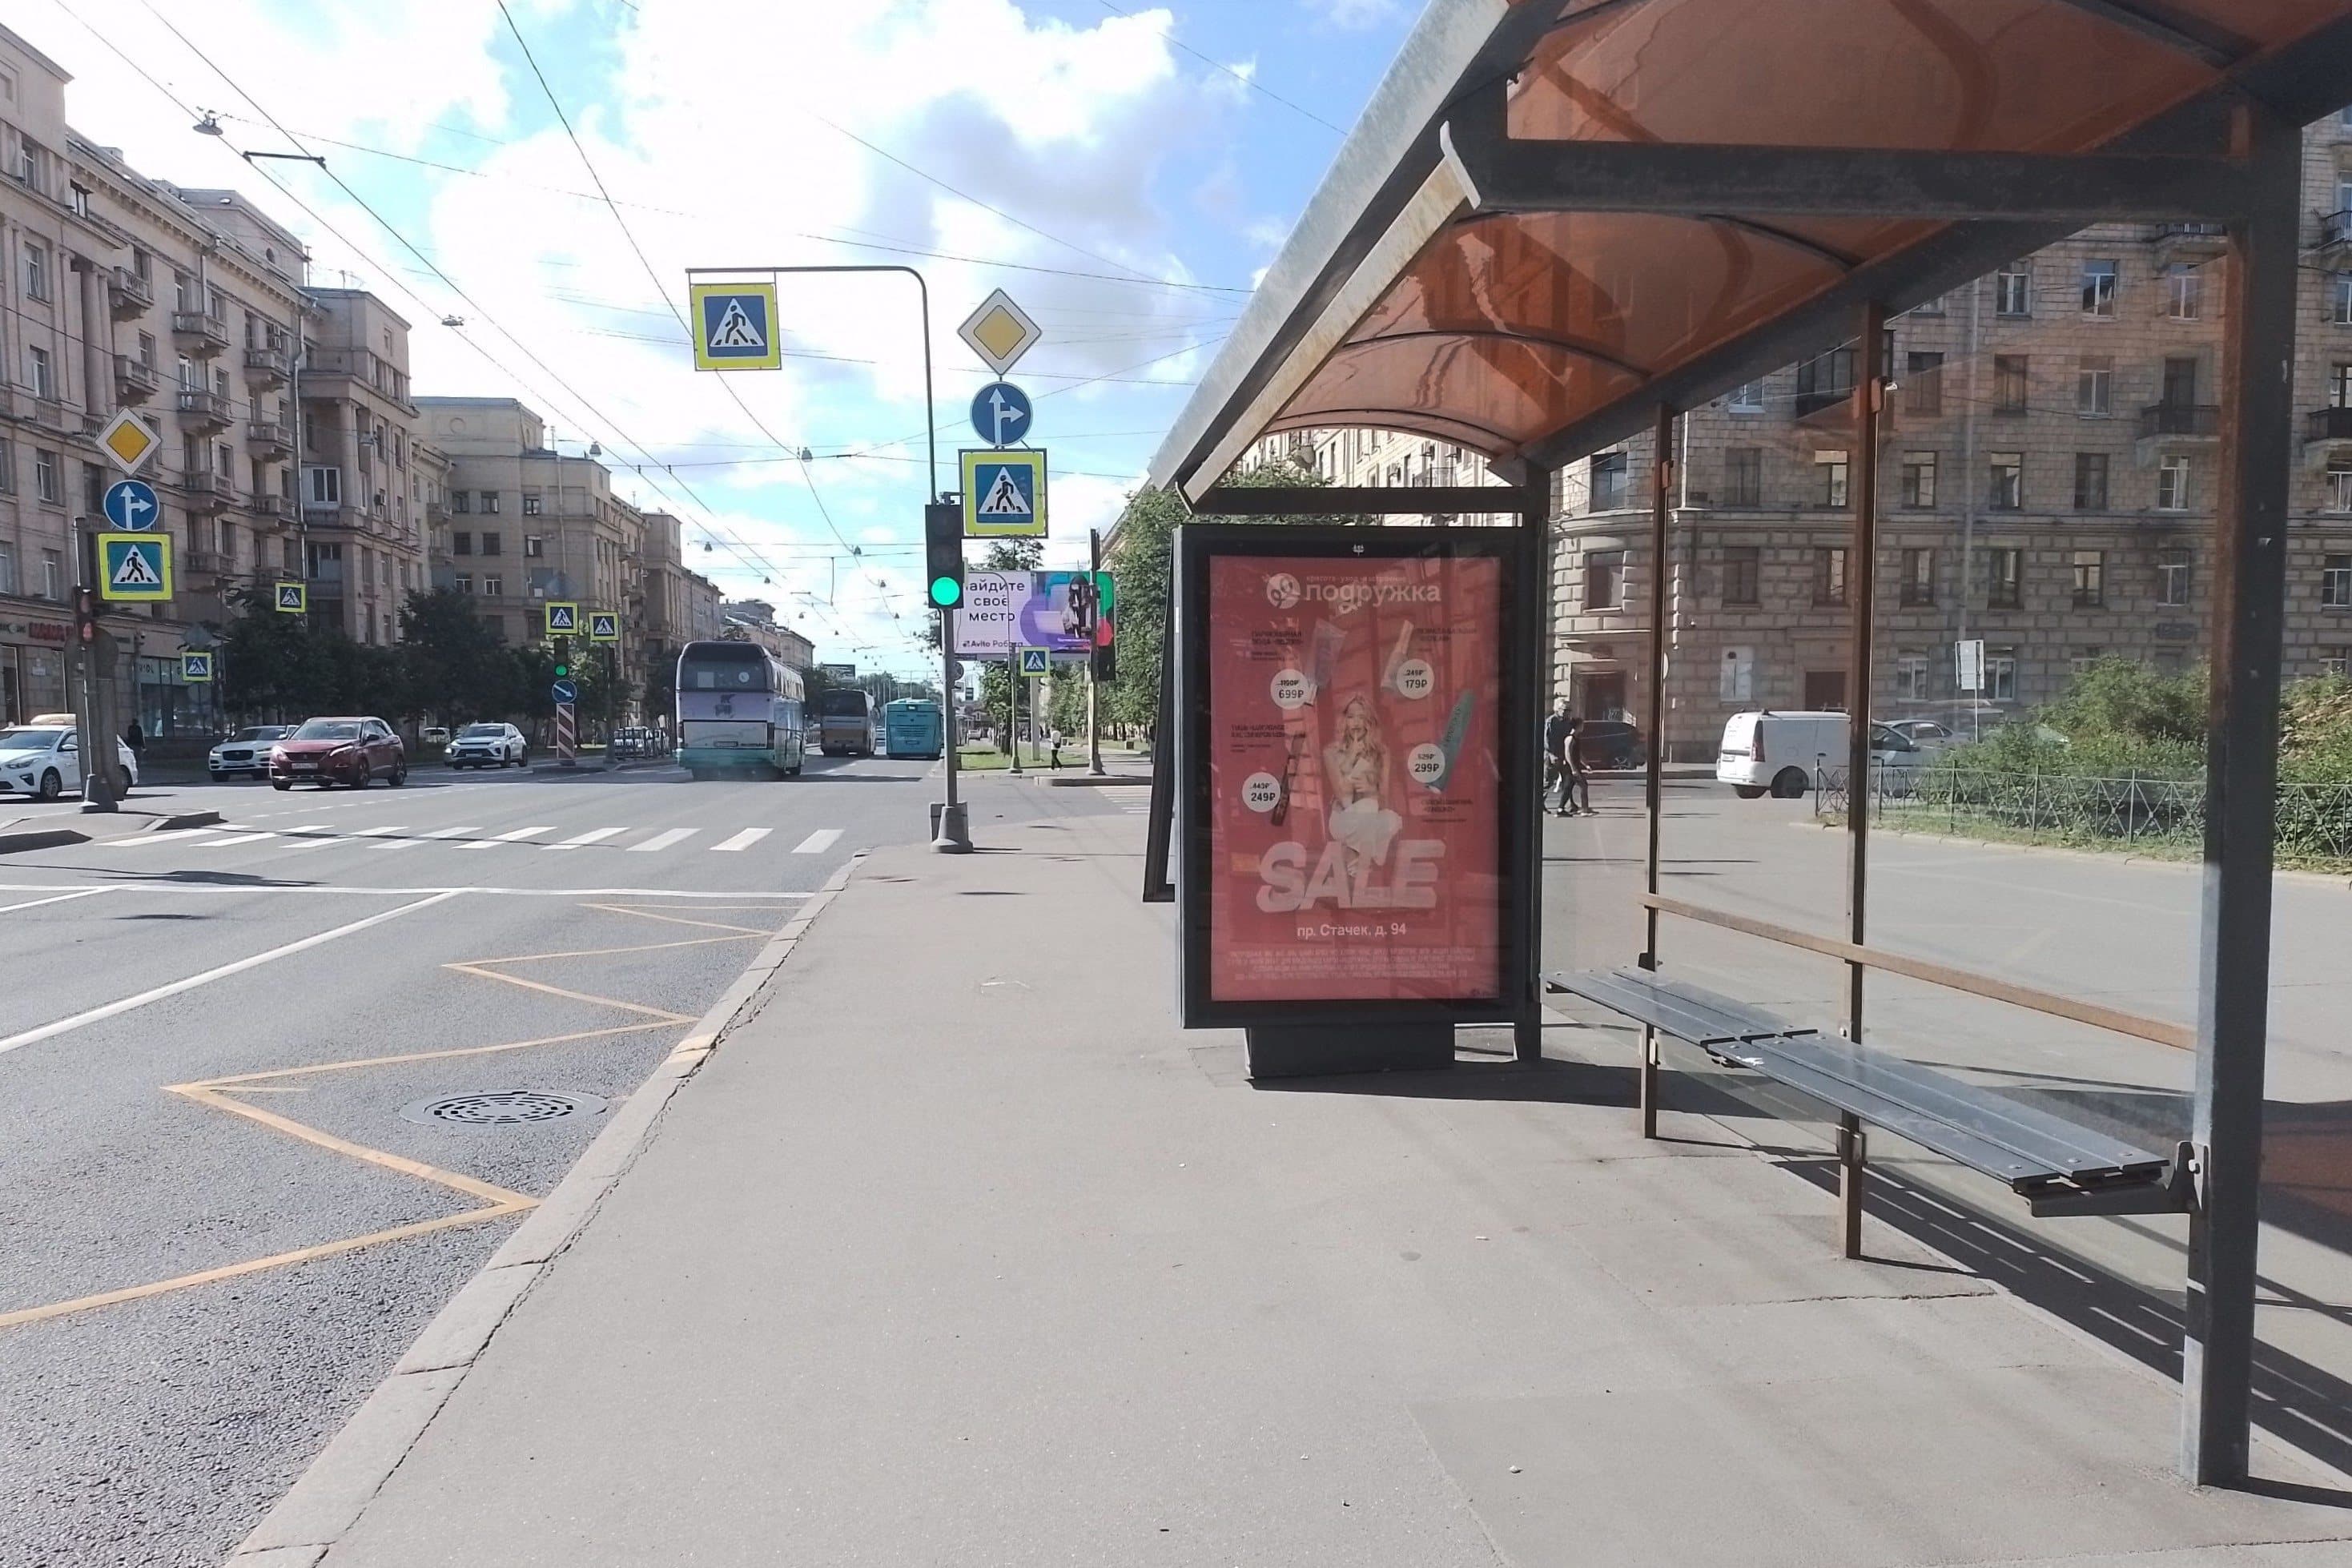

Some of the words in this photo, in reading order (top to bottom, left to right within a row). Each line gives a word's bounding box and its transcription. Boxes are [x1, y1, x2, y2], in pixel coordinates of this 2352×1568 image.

[966, 578, 1025, 593] айдите
[1306, 583, 1441, 614] подружка
[969, 613, 1015, 621] место
[1256, 839, 1446, 912] SALE
[1297, 927, 1316, 939] пр.
[1374, 924, 1387, 937] д.
[1391, 923, 1406, 935] 94
